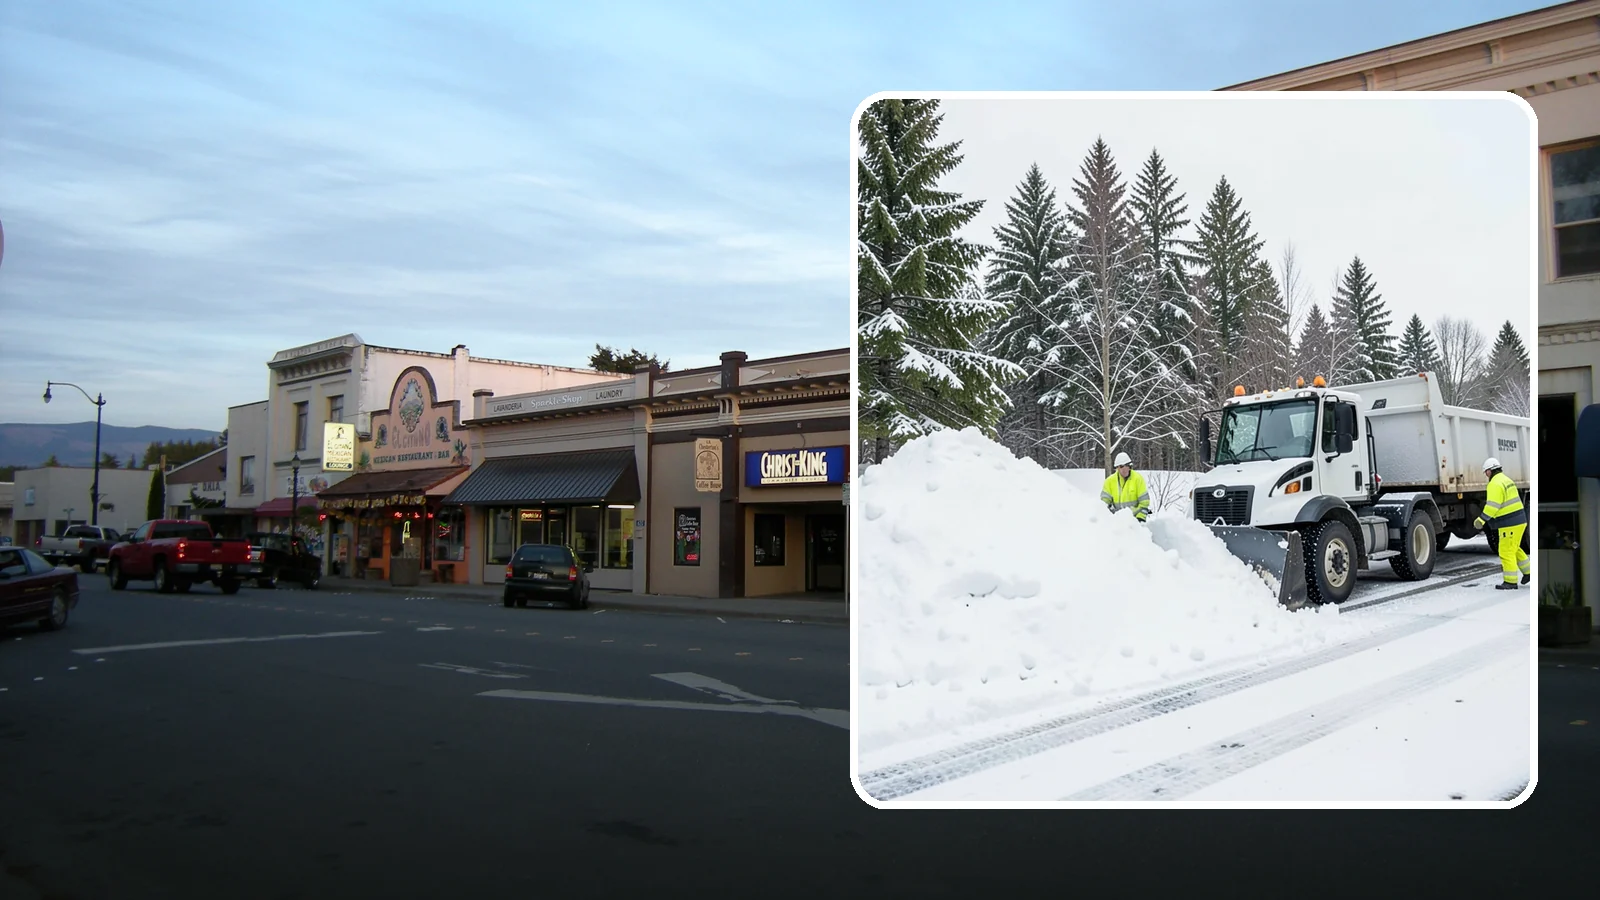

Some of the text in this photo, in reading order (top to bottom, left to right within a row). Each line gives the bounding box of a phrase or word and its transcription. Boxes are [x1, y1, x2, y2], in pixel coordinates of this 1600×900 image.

[493, 389, 623, 412] LAVANDERIA Sparkle Shop LAUNDRY
[374, 456, 395, 464] MEXICAN
[398, 452, 433, 462] RESTAURANT
[438, 450, 450, 458] BAR
[761, 450, 827, 478] CHRIST KING
[697, 480, 721, 488] Coffee House
